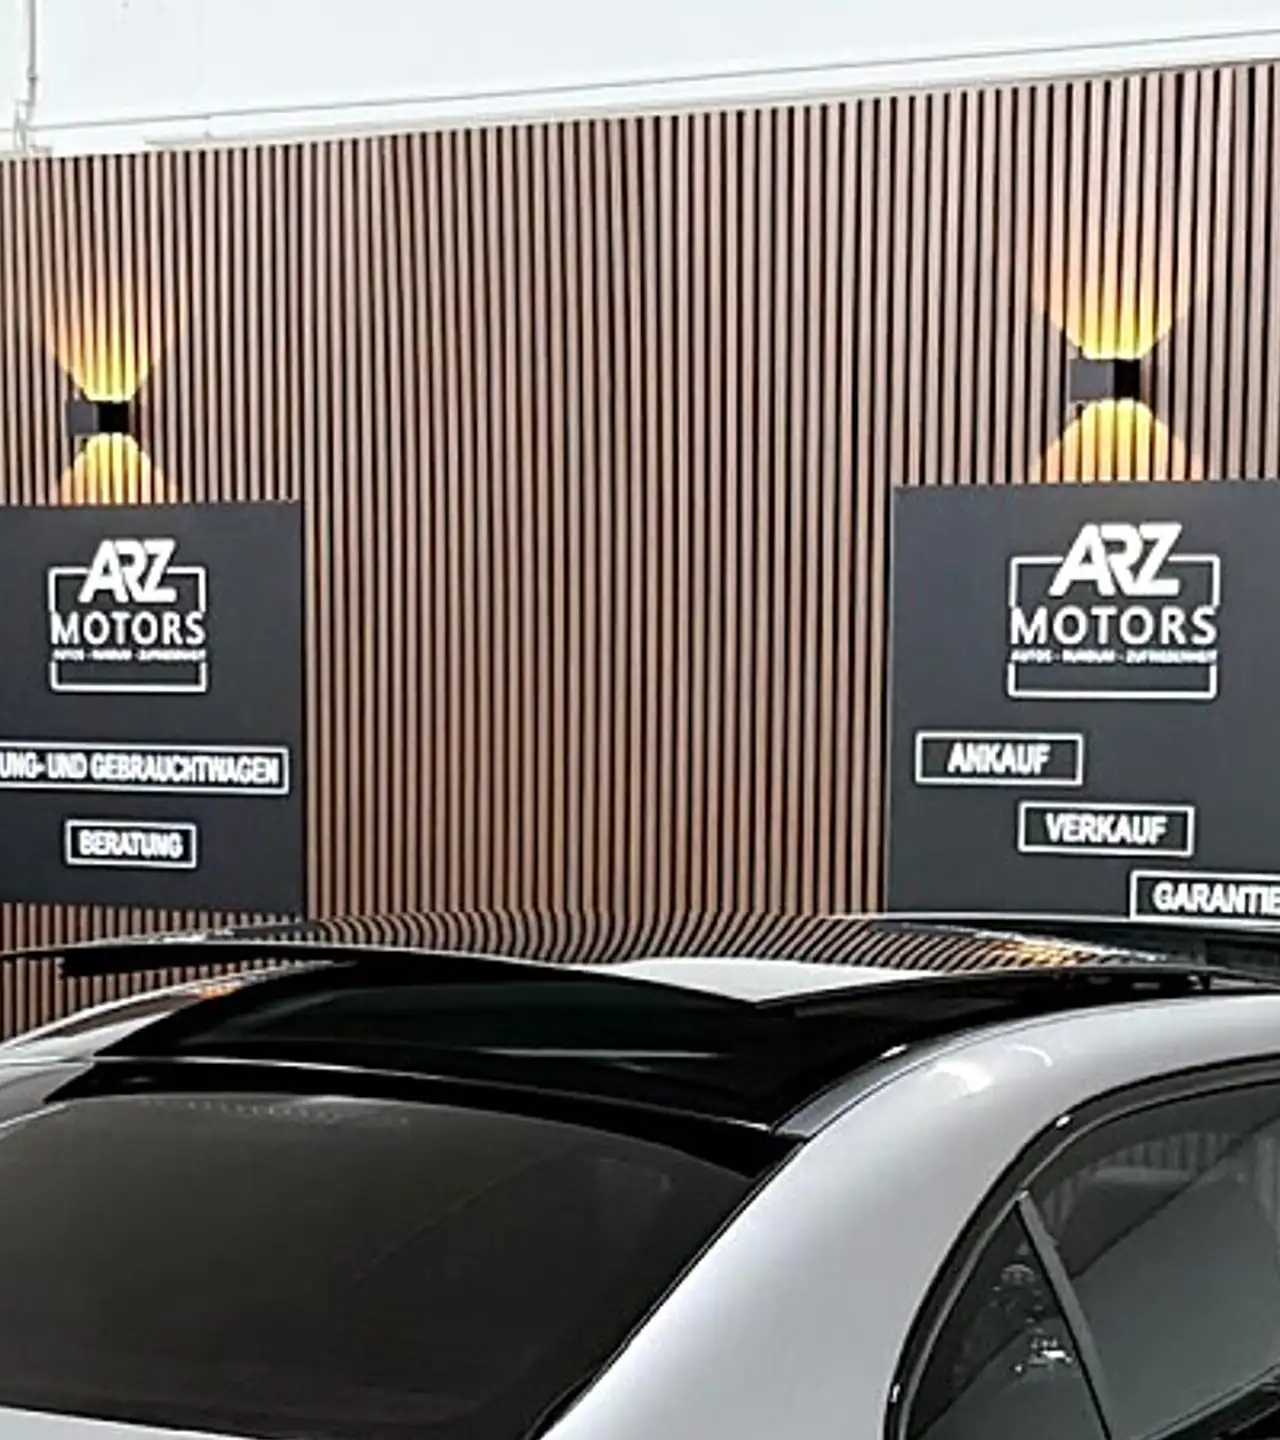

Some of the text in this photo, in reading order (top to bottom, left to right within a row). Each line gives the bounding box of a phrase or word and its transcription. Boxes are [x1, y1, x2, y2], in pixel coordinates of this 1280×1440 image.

[79, 538, 177, 603] ARZ
[1048, 521, 1183, 597] ARZ
[50, 610, 206, 646] MOTORS
[1009, 605, 1218, 646] MOTORS
[47, 753, 88, 780] UND
[90, 754, 280, 785] GEBRAUCHTWAGEN
[947, 743, 1052, 775] ANKAUF
[78, 829, 184, 859] BERATUNG
[1045, 812, 1169, 845] VERKAUF
